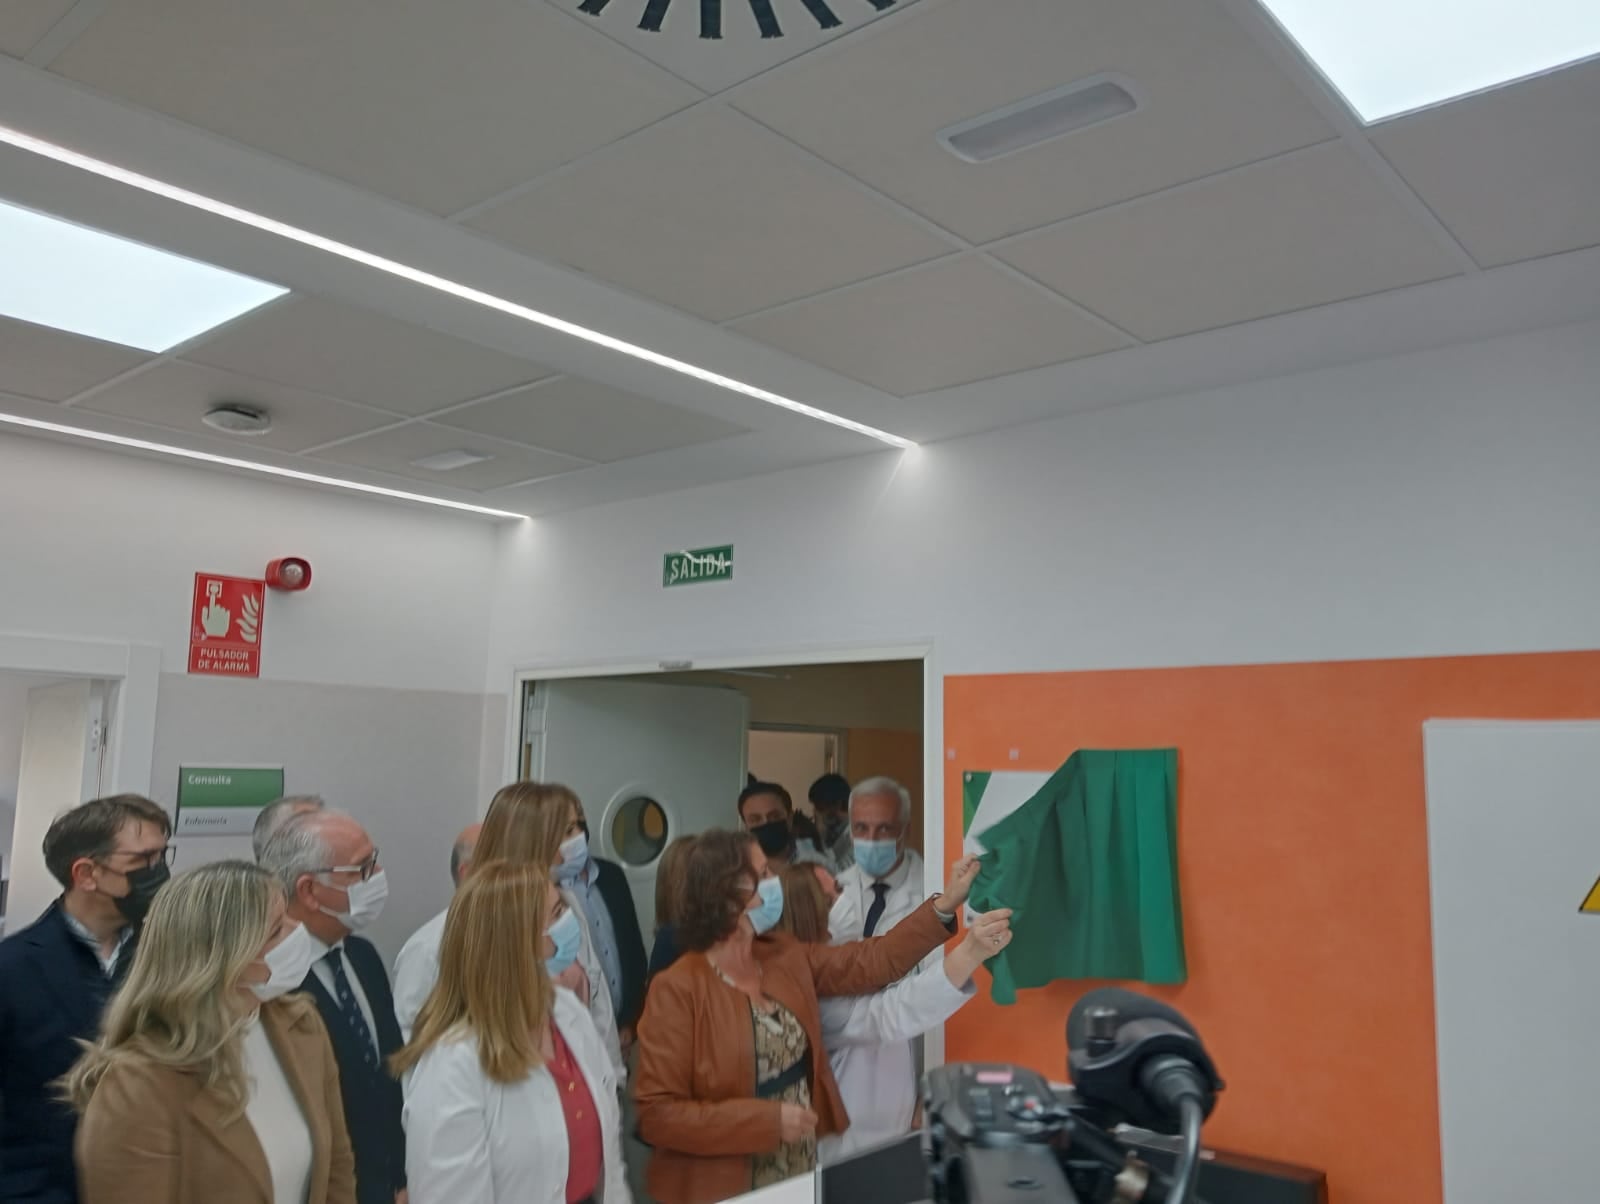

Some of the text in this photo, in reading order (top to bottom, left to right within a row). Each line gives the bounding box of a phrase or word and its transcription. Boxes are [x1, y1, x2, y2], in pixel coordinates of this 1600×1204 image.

[671, 552, 726, 580] SALIDA
[201, 648, 249, 661] PULSADOR
[198, 659, 250, 673] DE ALARMA
[188, 774, 232, 785] Consulta
